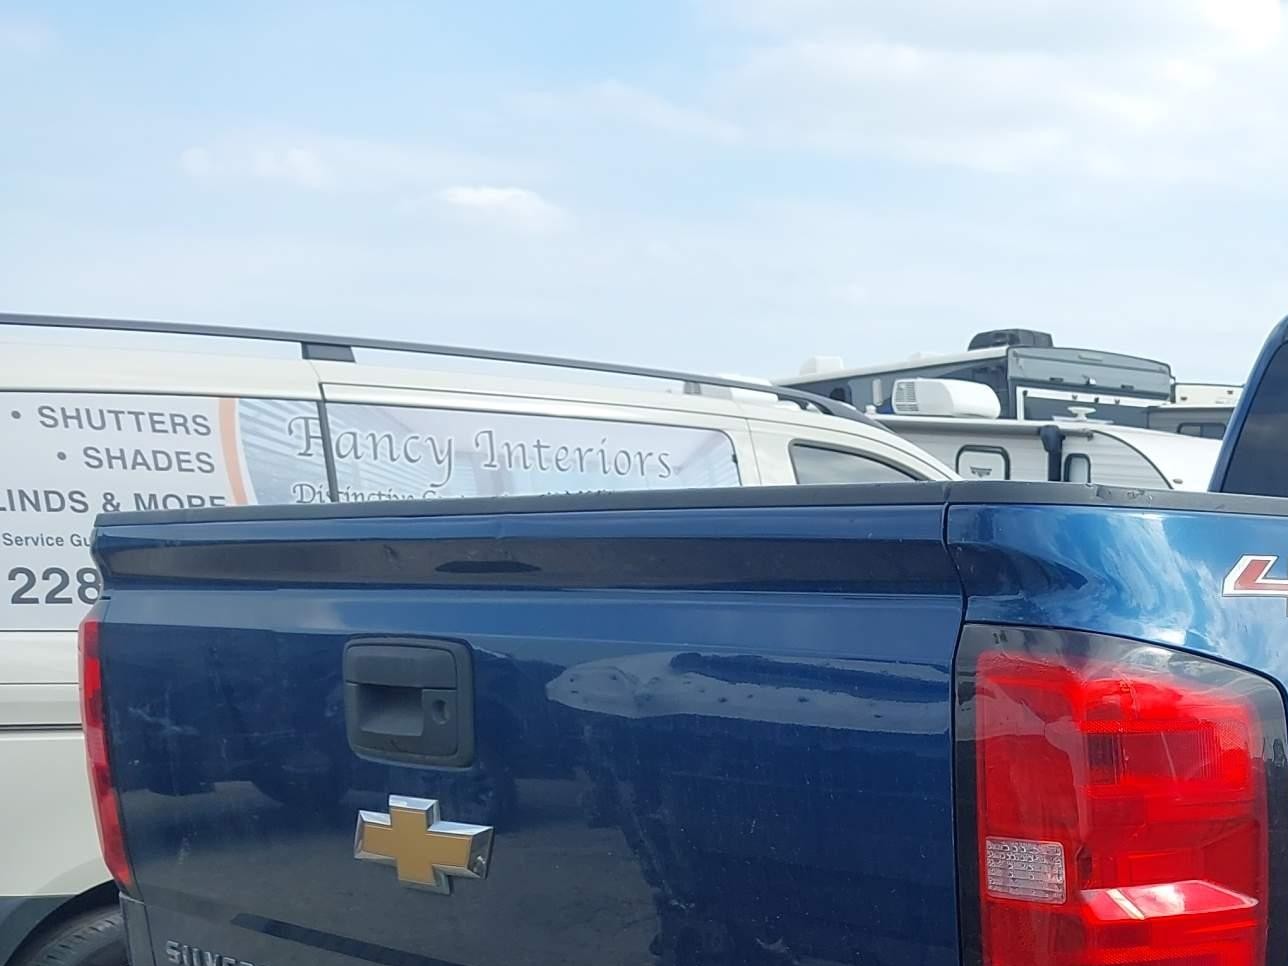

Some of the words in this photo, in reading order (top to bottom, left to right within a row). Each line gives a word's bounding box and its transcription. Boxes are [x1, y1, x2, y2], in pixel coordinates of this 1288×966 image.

[38, 405, 212, 436] SHUTTERS
[82, 446, 216, 473] SHADES
[288, 416, 453, 488] Fancy
[474, 429, 672, 478] Interiors
[2, 532, 64, 547] Service
[8, 567, 101, 605] 228
